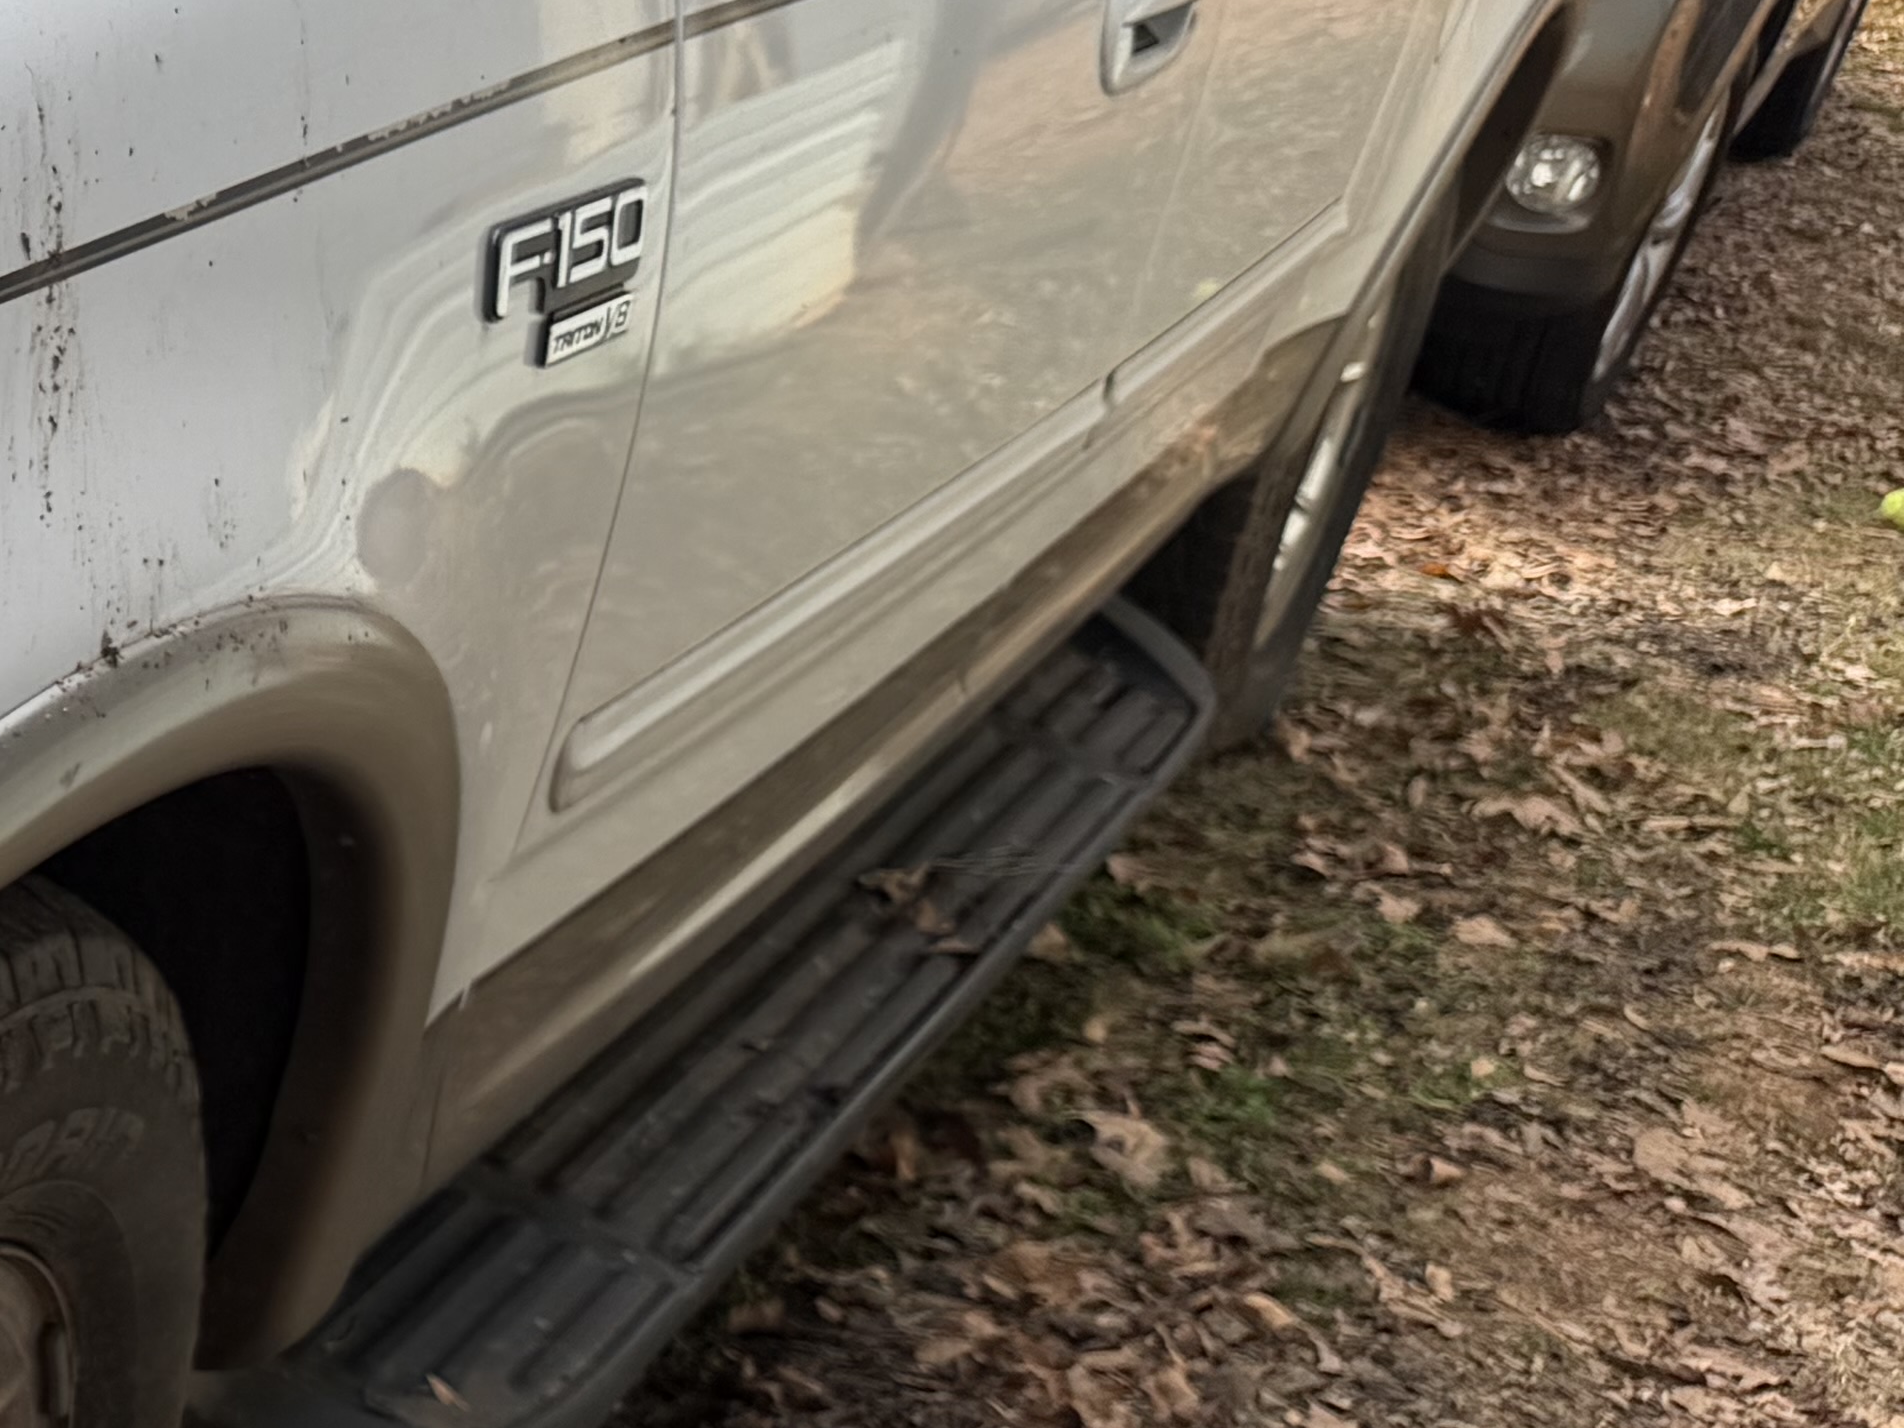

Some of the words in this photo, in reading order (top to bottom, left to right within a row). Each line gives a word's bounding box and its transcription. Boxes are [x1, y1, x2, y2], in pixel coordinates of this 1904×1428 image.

[495, 185, 647, 319] F-150
[553, 317, 604, 354] TRITON
[603, 299, 632, 342] V8
